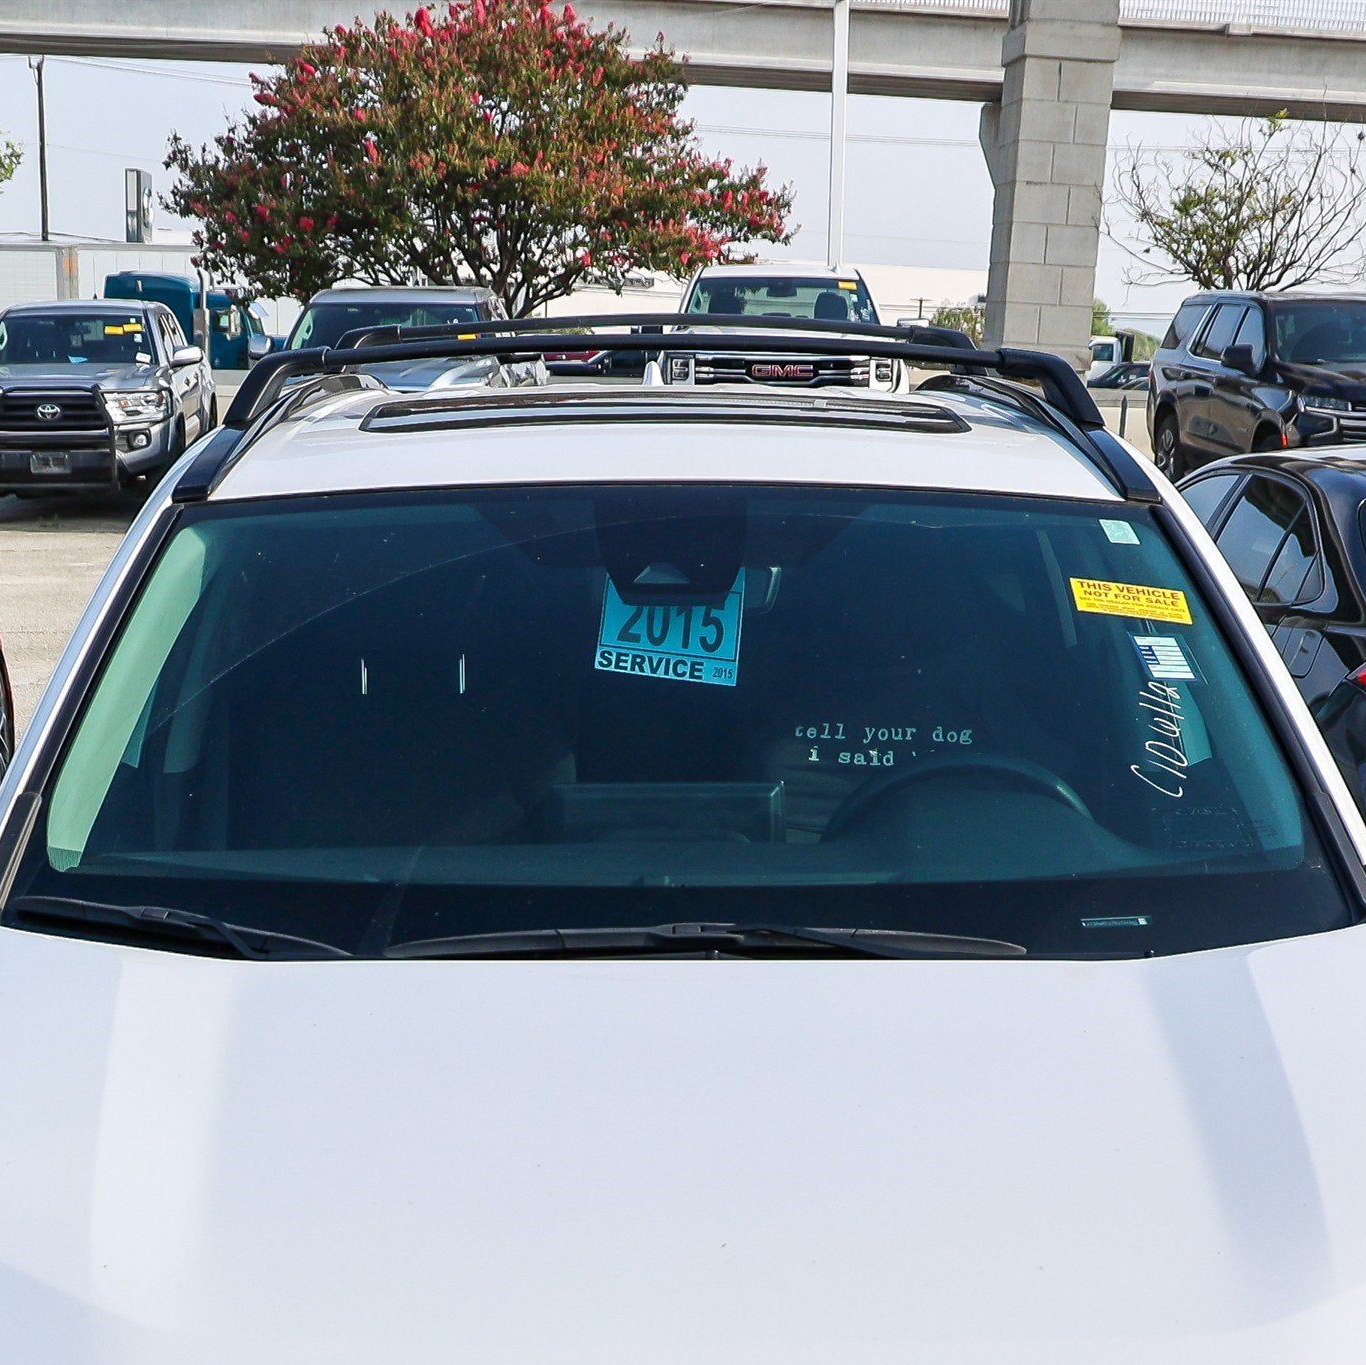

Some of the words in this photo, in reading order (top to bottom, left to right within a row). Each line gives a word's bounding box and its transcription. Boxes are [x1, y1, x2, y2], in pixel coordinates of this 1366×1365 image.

[751, 364, 814, 377] GMC
[1076, 580, 1113, 592] THIS
[1115, 584, 1181, 601] VEHICLE
[1083, 590, 1110, 598] NOT
[1114, 593, 1142, 602] FOR
[1145, 597, 1179, 607] SALE
[616, 606, 724, 653] 2015
[597, 650, 705, 681] SERVICE
[712, 666, 733, 680] 2015
[794, 723, 847, 740] tell
[862, 726, 917, 744] your
[932, 726, 973, 745] dog
[837, 750, 895, 766] said
